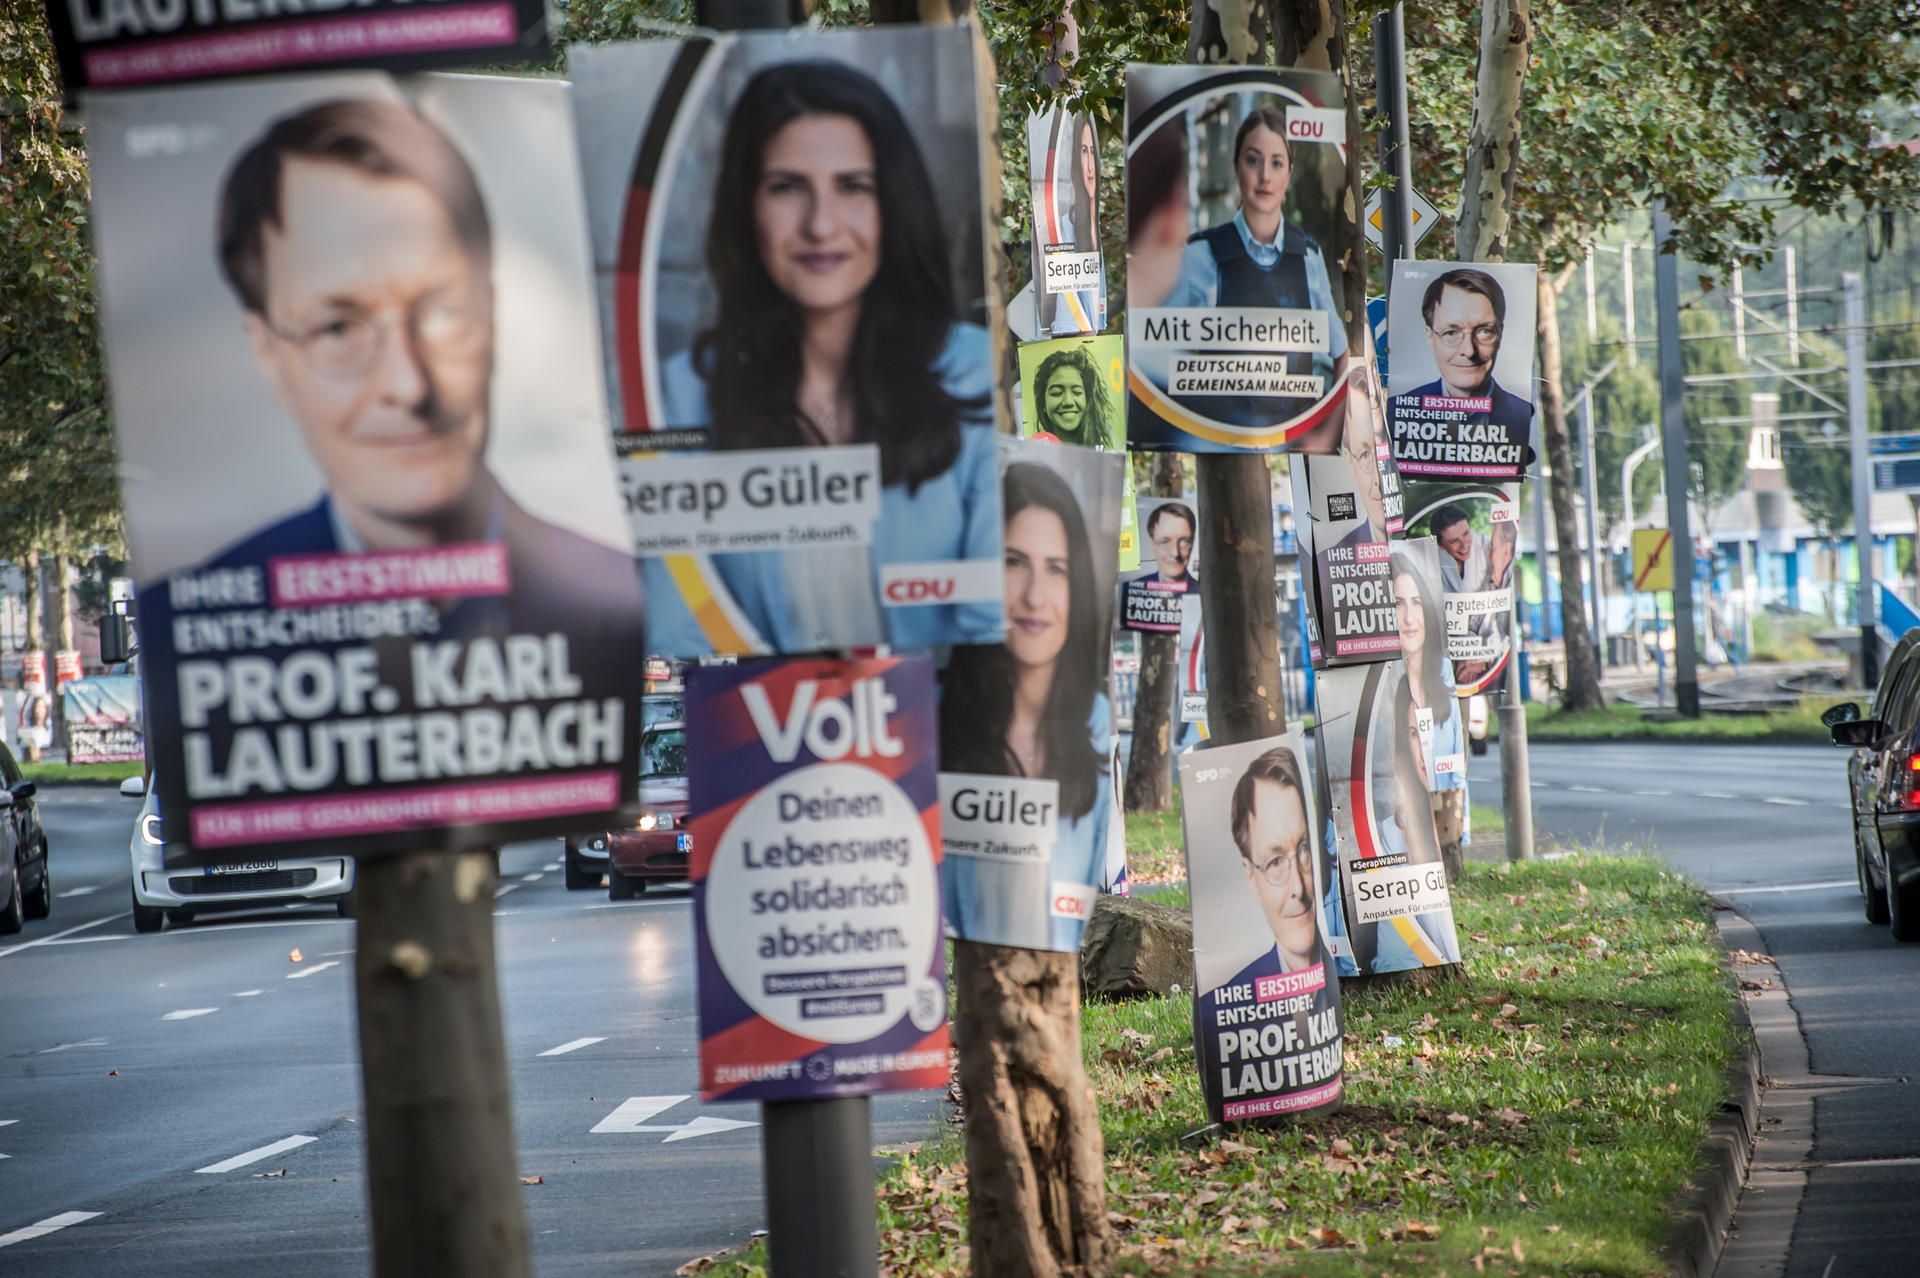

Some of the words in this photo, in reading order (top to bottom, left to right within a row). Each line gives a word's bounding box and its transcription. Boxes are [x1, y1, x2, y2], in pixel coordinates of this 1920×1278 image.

[1289, 119, 1323, 137] CDU
[1047, 261, 1080, 279] Serap
[1144, 317, 1191, 342] Mit
[1200, 316, 1321, 345] Sicherheit.
[1176, 360, 1281, 374] DEUTSCHLAND
[1176, 378, 1267, 391] GEMEINSAM
[1269, 379, 1318, 393] MACHEN.
[1396, 396, 1420, 406] IHRE
[1424, 399, 1490, 409] ERSTSTIMME
[1395, 408, 1467, 421] ENTSCHEIDET:
[1394, 421, 1452, 441] PROF.
[1458, 424, 1509, 443] KARL
[1393, 440, 1521, 463] LAUTERBACH
[741, 460, 872, 509] Güler
[1492, 510, 1509, 520] CDU
[1327, 547, 1354, 562] IHRE
[170, 568, 261, 609] IHRE
[279, 549, 503, 600] ERSTSTIMME
[884, 577, 956, 602] CDU
[1127, 597, 1164, 611] PROF.
[1331, 581, 1387, 608] PROF.
[1456, 598, 1485, 615] gutes
[1338, 640, 1352, 651] FÜR
[1353, 639, 1369, 650] IHRE
[178, 647, 399, 728] PROF.
[410, 632, 583, 708] KARL
[739, 678, 904, 763] Volt
[184, 698, 623, 799] LAUTERBACH
[1195, 768, 1218, 783] SPD
[1436, 762, 1453, 771] CDU
[778, 788, 883, 823] Deinen
[950, 788, 1053, 826] Güler
[742, 836, 910, 869] Lebensweg
[983, 840, 1043, 858] Zukunft.
[1352, 854, 1407, 870] #SerapWählen
[750, 875, 907, 917] solidarisch
[1358, 878, 1420, 902] Serap
[1362, 906, 1407, 921] Anpacken.
[1408, 904, 1421, 913] Für
[757, 921, 909, 960] absichern.
[1214, 984, 1253, 1005] IHRE
[1216, 994, 1314, 1027] ENTSCHEIDET:
[1218, 1020, 1305, 1064] PROF.
[1226, 1102, 1246, 1117] FÜR
[1247, 1100, 1271, 1115] IHRE
